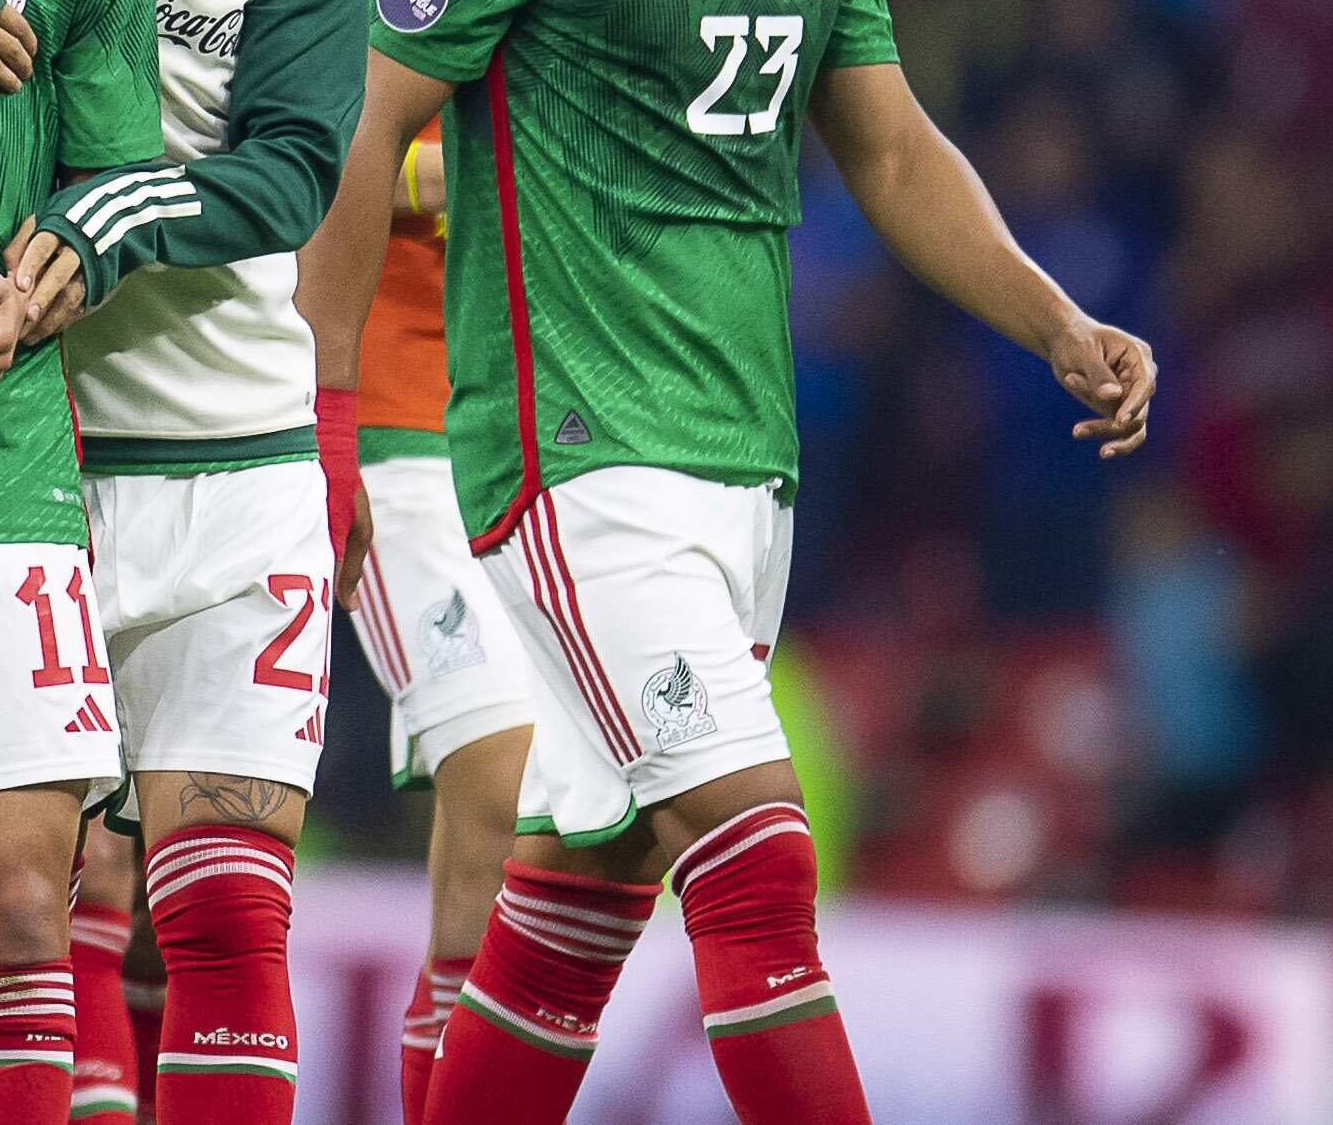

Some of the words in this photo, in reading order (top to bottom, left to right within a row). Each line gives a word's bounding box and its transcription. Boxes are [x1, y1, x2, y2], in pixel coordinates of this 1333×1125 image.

[686, 15, 804, 135] 23
[15, 566, 110, 688] 11
[193, 1027, 289, 1050] MÉXICO
